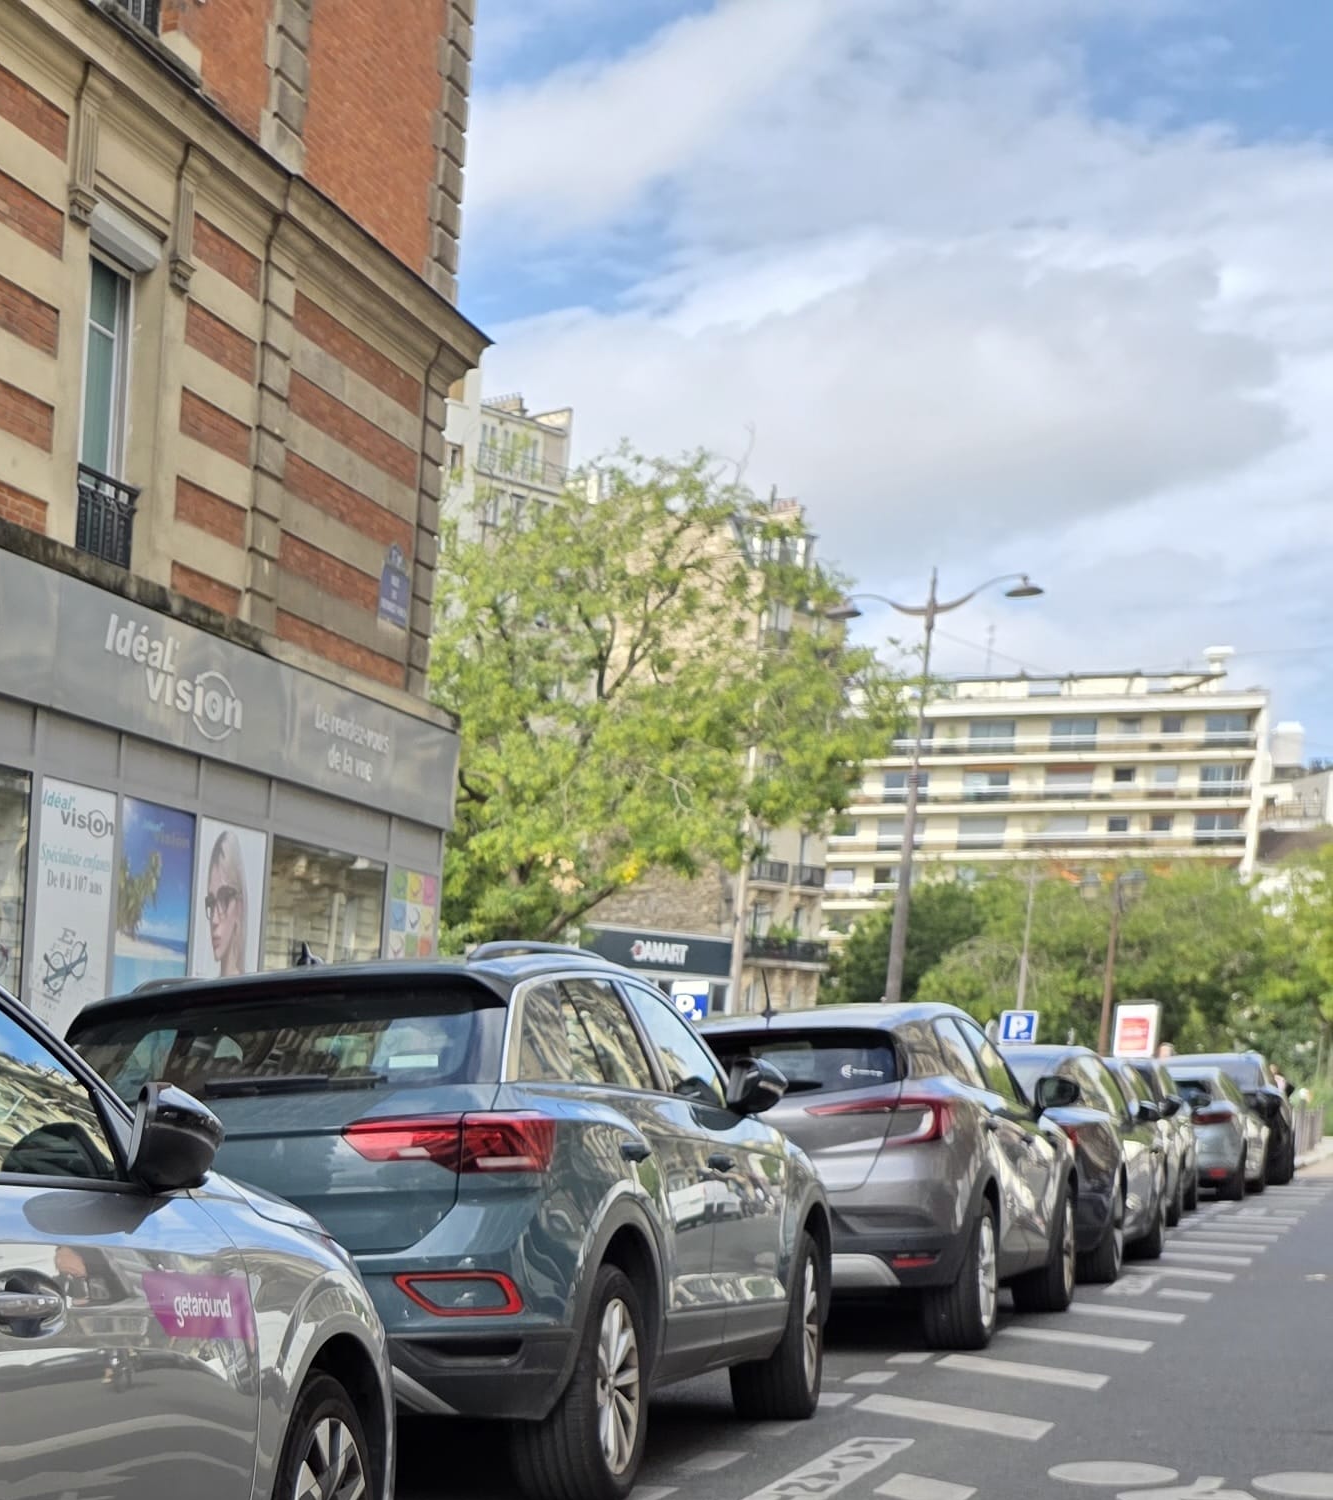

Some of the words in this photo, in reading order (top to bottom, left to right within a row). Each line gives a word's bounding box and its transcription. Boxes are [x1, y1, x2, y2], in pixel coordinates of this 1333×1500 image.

[146, 667, 243, 731] vision
[61, 808, 114, 837] vision
[47, 869, 58, 888] De
[632, 940, 689, 966] DAMART
[174, 1291, 232, 1328] getaround
